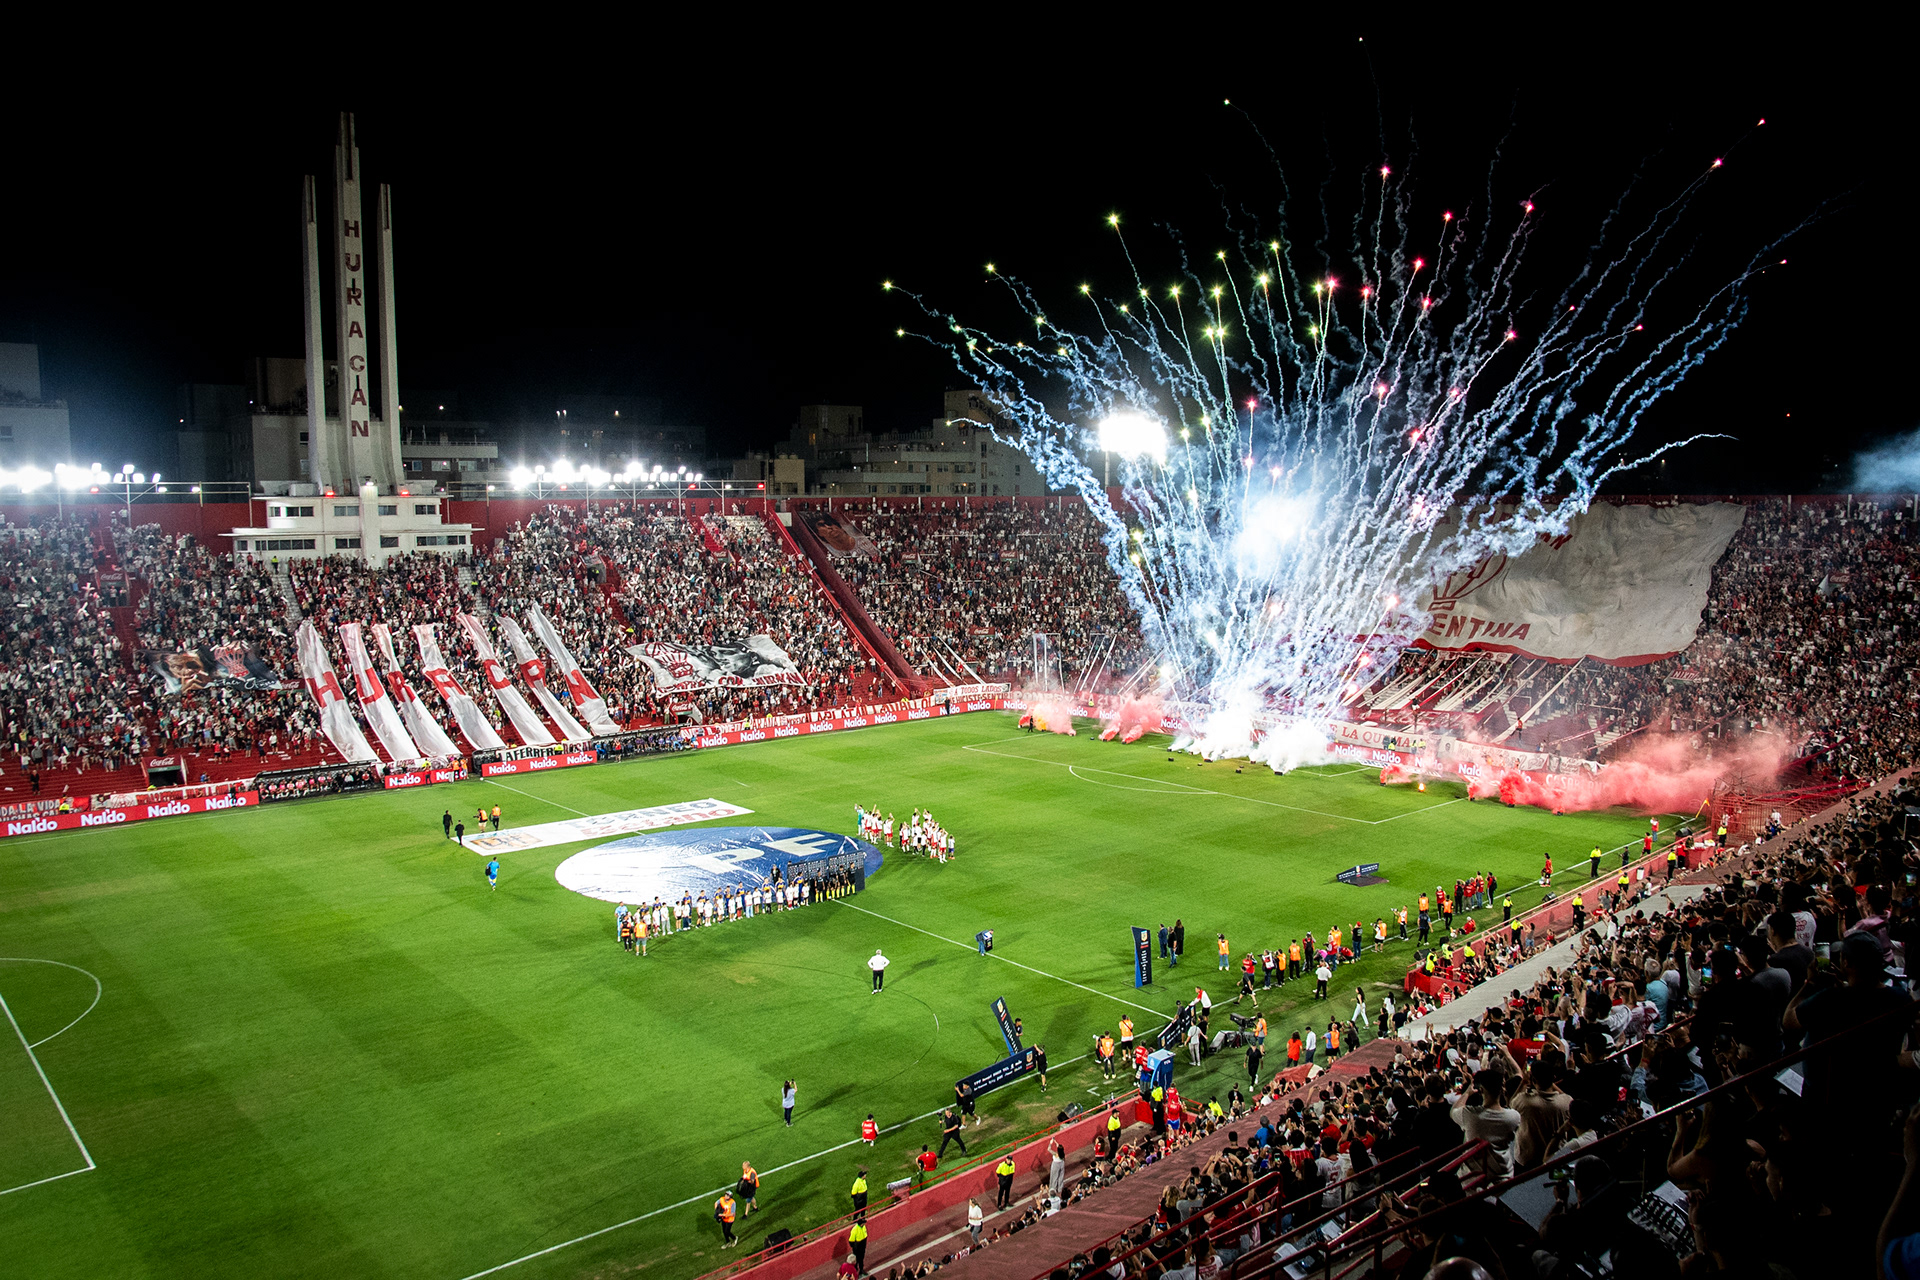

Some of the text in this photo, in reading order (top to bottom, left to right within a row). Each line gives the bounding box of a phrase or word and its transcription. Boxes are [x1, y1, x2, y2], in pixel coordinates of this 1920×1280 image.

[343, 219, 370, 437] HURACAN
[940, 704, 960, 715] Nldo
[967, 699, 991, 711] Naldo
[1003, 700, 1028, 710] Naldo
[1067, 706, 1088, 717] Naldo
[875, 711, 898, 724] Naldo
[908, 707, 930, 720] Naldo
[810, 720, 833, 732] Naldo
[844, 716, 867, 728] Naldo
[1161, 718, 1182, 730] Naldo
[740, 729, 766, 742] Naldo
[774, 723, 799, 736] Naldo
[1341, 726, 1359, 740] LA
[702, 733, 728, 747] Naldo
[1335, 744, 1362, 758] Naldo
[1372, 750, 1401, 764] Naldo
[150, 757, 174, 767] Coca-Cola
[530, 756, 558, 769] Naldo
[567, 751, 594, 765] Naldo
[488, 761, 517, 775] Naldo
[389, 772, 421, 787] Naldo
[147, 800, 190, 818] Naldo
[81, 808, 126, 827] Naldo
[8, 817, 58, 836] Naldo
